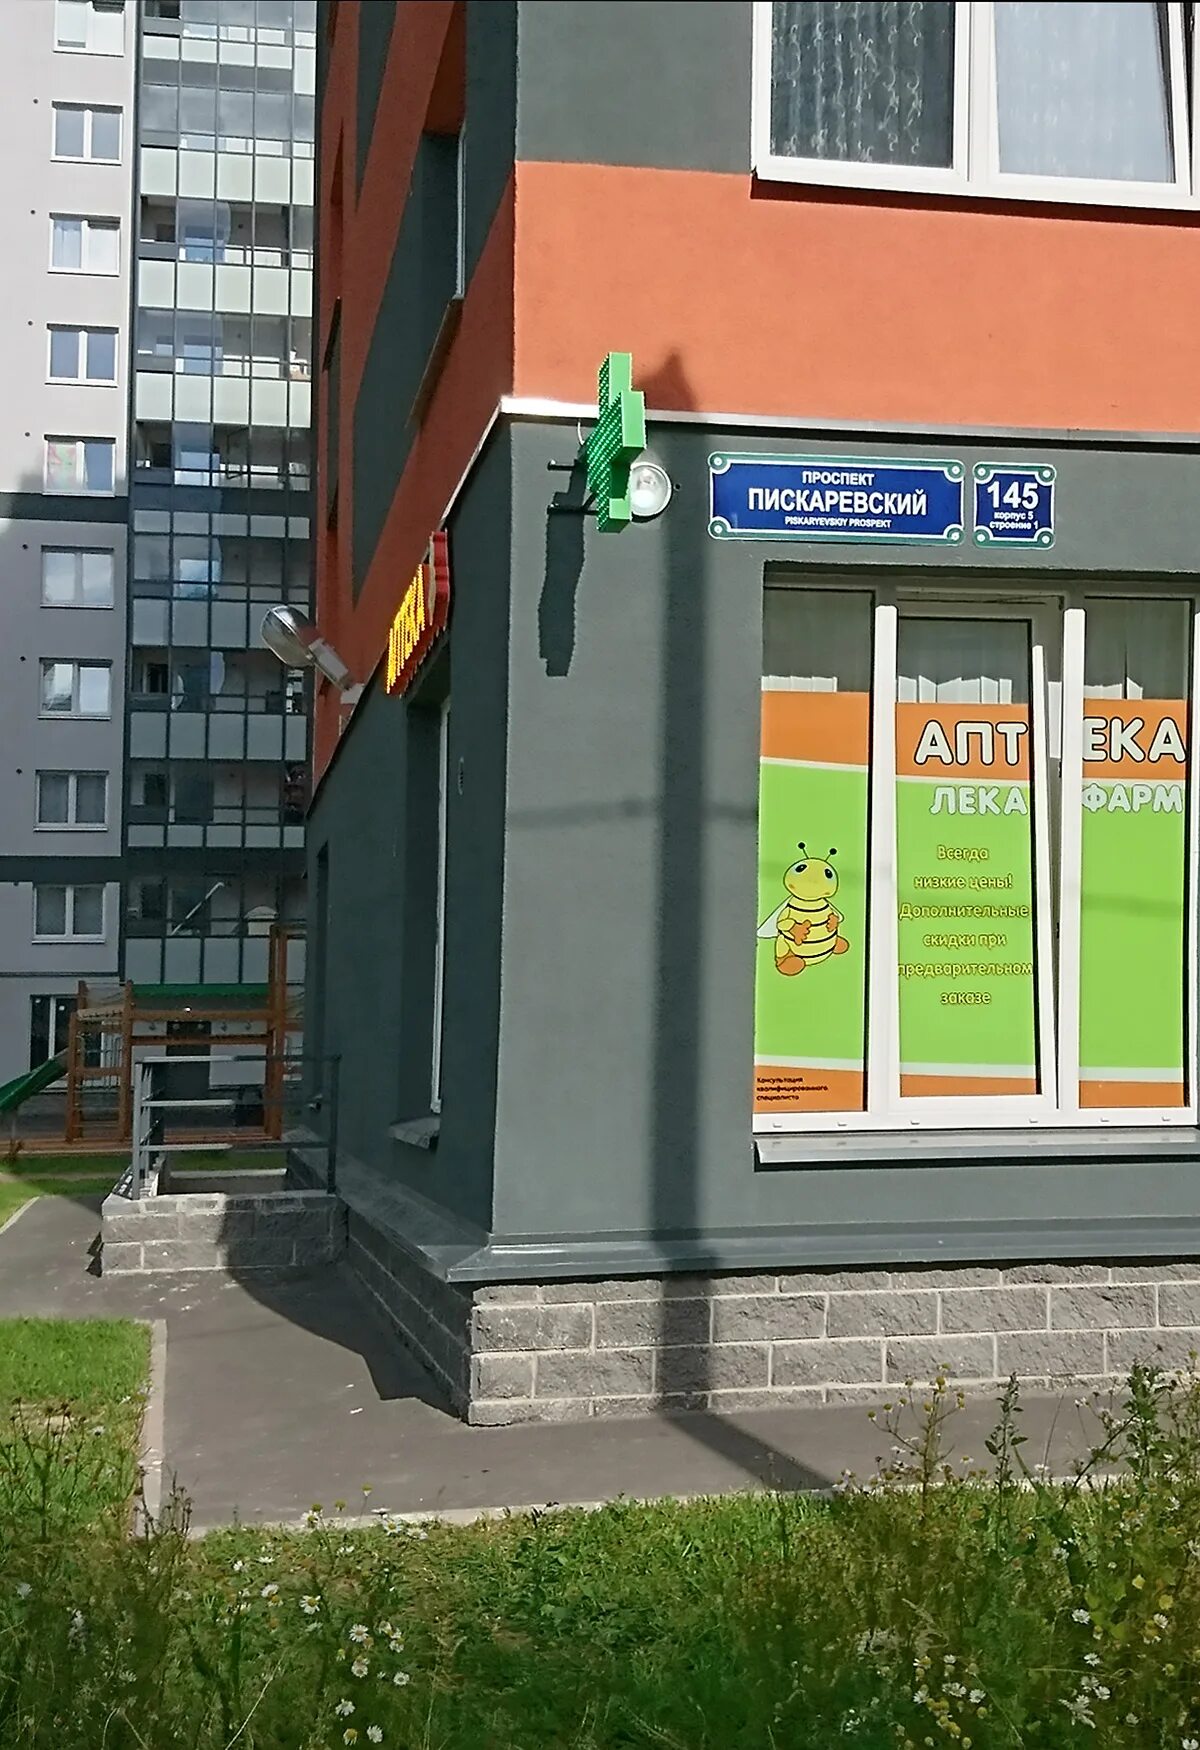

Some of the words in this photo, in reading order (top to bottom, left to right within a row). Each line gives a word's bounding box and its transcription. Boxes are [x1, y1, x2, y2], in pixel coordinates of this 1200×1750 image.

[802, 470, 875, 486] ПРОСПЕКТ
[748, 488, 928, 516] ПИСКАРЕВСКИЙ
[987, 481, 1039, 510] 145
[784, 515, 848, 527] PISKARYEVSKIY
[848, 517, 892, 528] PROSPEKT
[993, 511, 1026, 522] корпус
[1027, 511, 1034, 521] 5
[989, 520, 1032, 531] строение
[1033, 520, 1039, 530] 1
[929, 785, 1028, 816] ЛЕКА
[1082, 783, 1184, 814] ФАРМ
[937, 845, 988, 862] Всегда
[914, 875, 966, 889] низкие
[968, 872, 1013, 891] цены!
[899, 902, 1030, 920] Дополнительные
[923, 934, 976, 949] скидки
[979, 933, 1007, 950] при
[940, 991, 992, 1006] заказе
